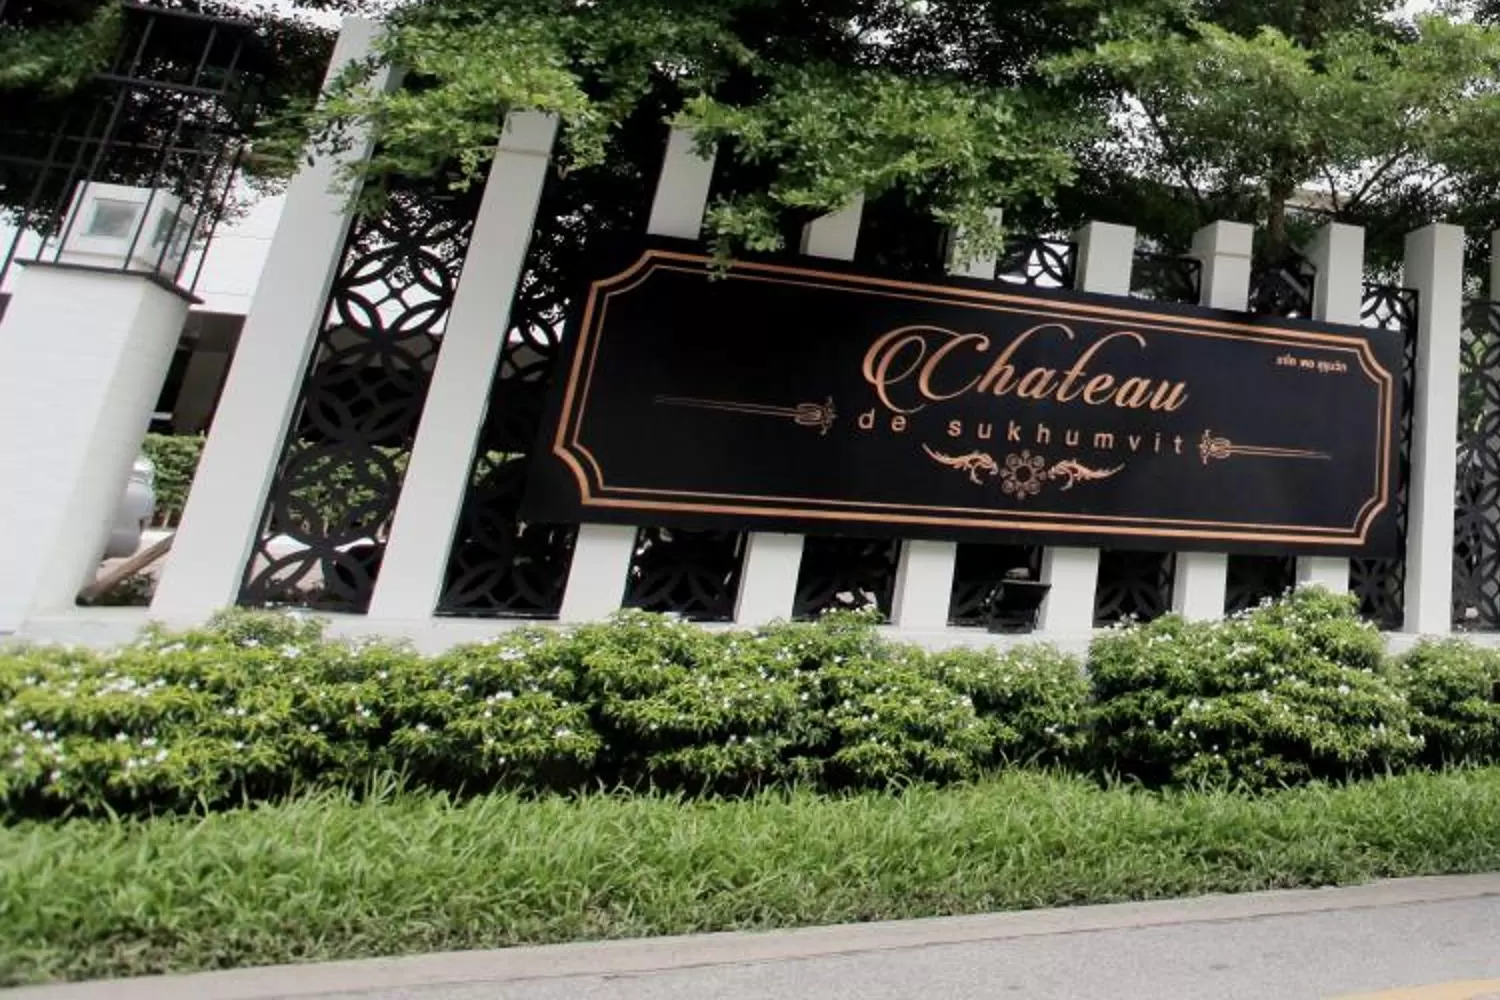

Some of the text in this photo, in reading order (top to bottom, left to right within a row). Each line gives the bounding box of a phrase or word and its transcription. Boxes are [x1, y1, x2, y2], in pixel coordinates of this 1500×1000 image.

[861, 322, 1188, 414] Chateau
[857, 408, 1184, 454] de sukhumvit
